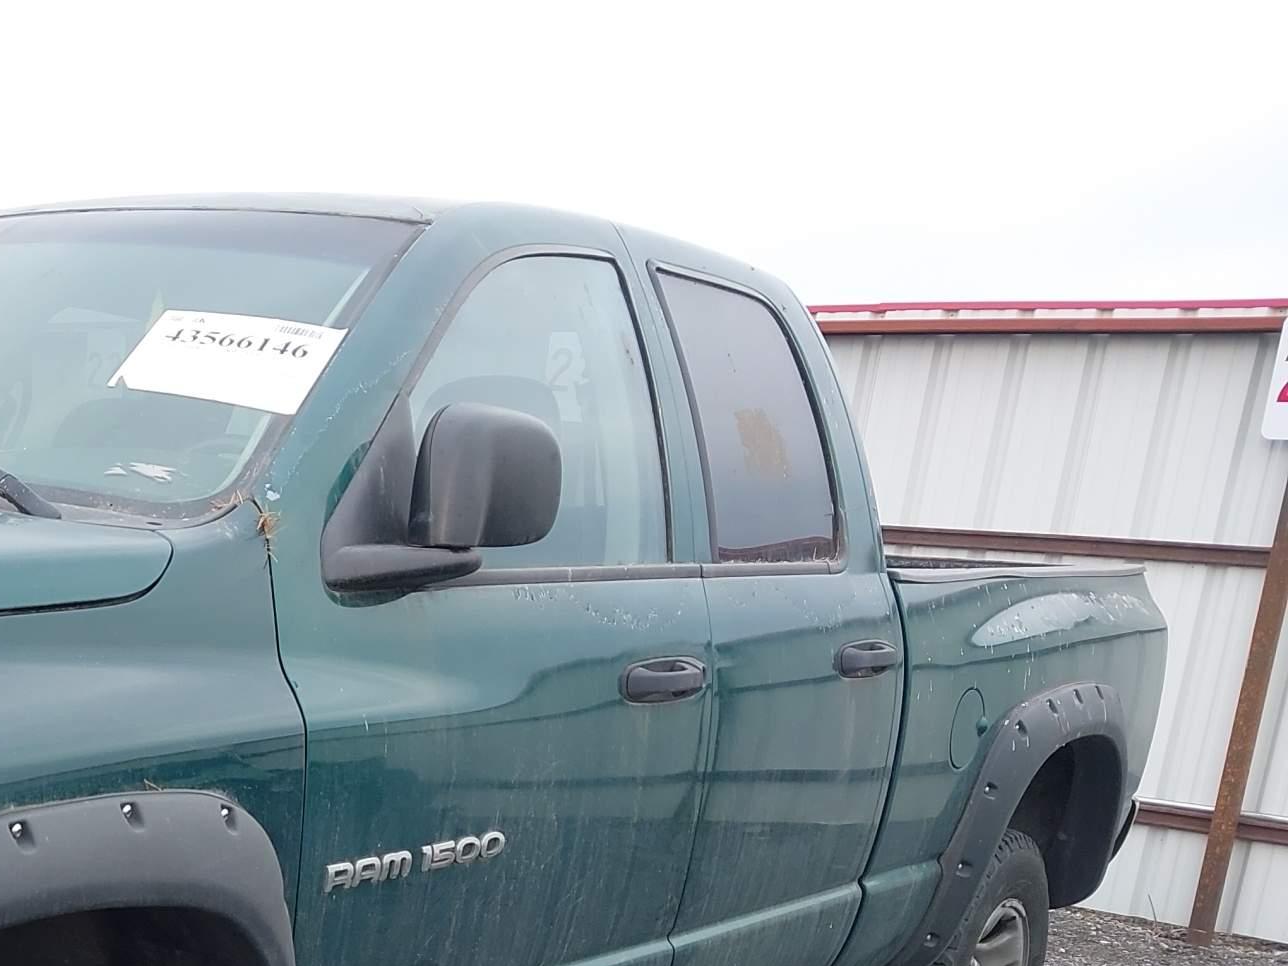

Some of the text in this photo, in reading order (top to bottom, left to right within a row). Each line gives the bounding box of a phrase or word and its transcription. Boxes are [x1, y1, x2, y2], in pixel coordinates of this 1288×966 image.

[164, 327, 310, 360] 43566146
[323, 830, 507, 894] RAM 1500
